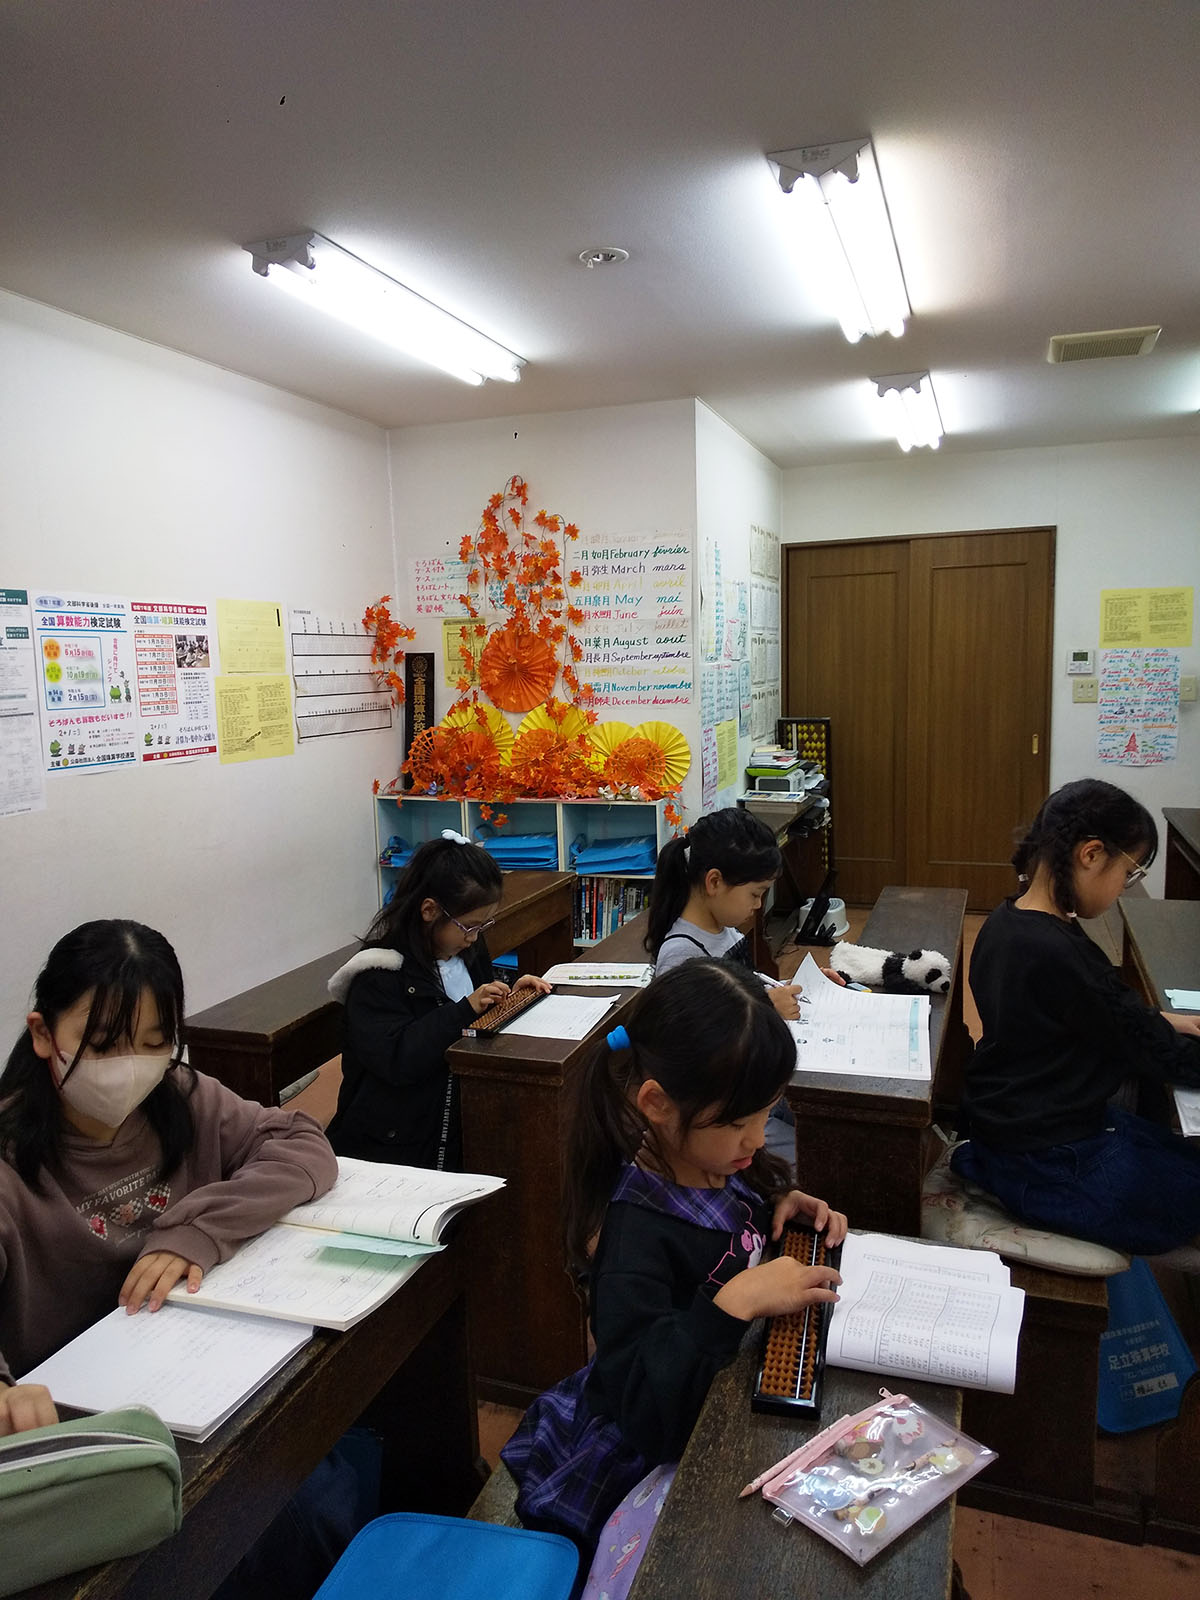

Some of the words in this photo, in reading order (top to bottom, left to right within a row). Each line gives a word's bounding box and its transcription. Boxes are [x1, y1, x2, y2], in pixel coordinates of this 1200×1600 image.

[610, 548, 650, 559] February
[611, 562, 646, 574] March
[616, 594, 643, 606] May
[656, 592, 683, 603] mai
[612, 610, 639, 620] June
[613, 637, 648, 649] August
[611, 651, 653, 664] September
[612, 682, 652, 693] November
[612, 695, 650, 705] December
[76, 1200, 93, 1213] MY
[94, 1177, 145, 1206] FAVORITE
